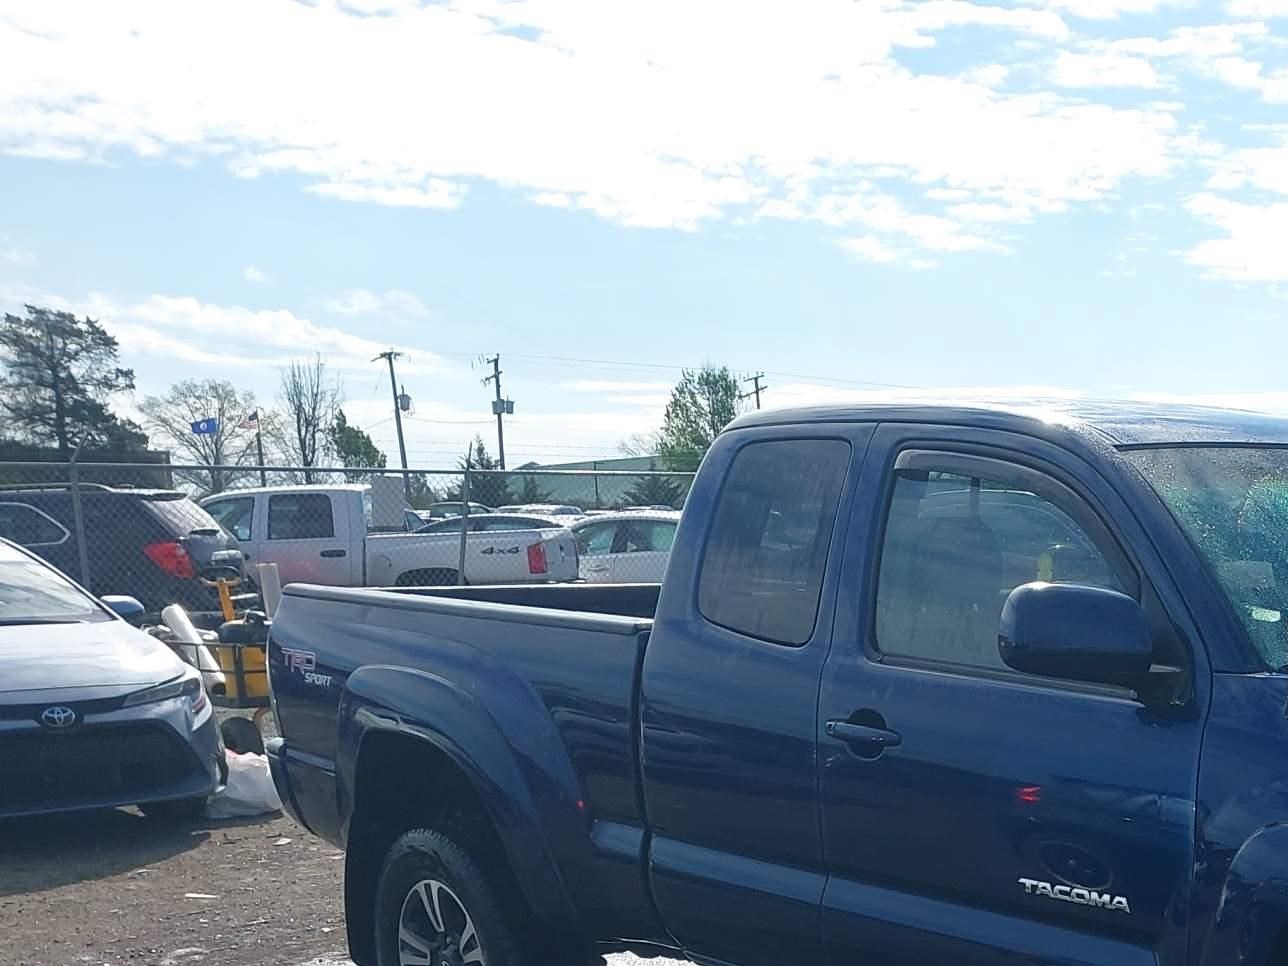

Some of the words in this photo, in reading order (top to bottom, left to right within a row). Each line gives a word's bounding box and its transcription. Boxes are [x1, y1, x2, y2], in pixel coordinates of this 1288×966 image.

[480, 546, 520, 555] 4x4
[281, 647, 316, 675] TRD
[304, 672, 333, 687] SPORT
[1017, 877, 1131, 914] TACOMA
